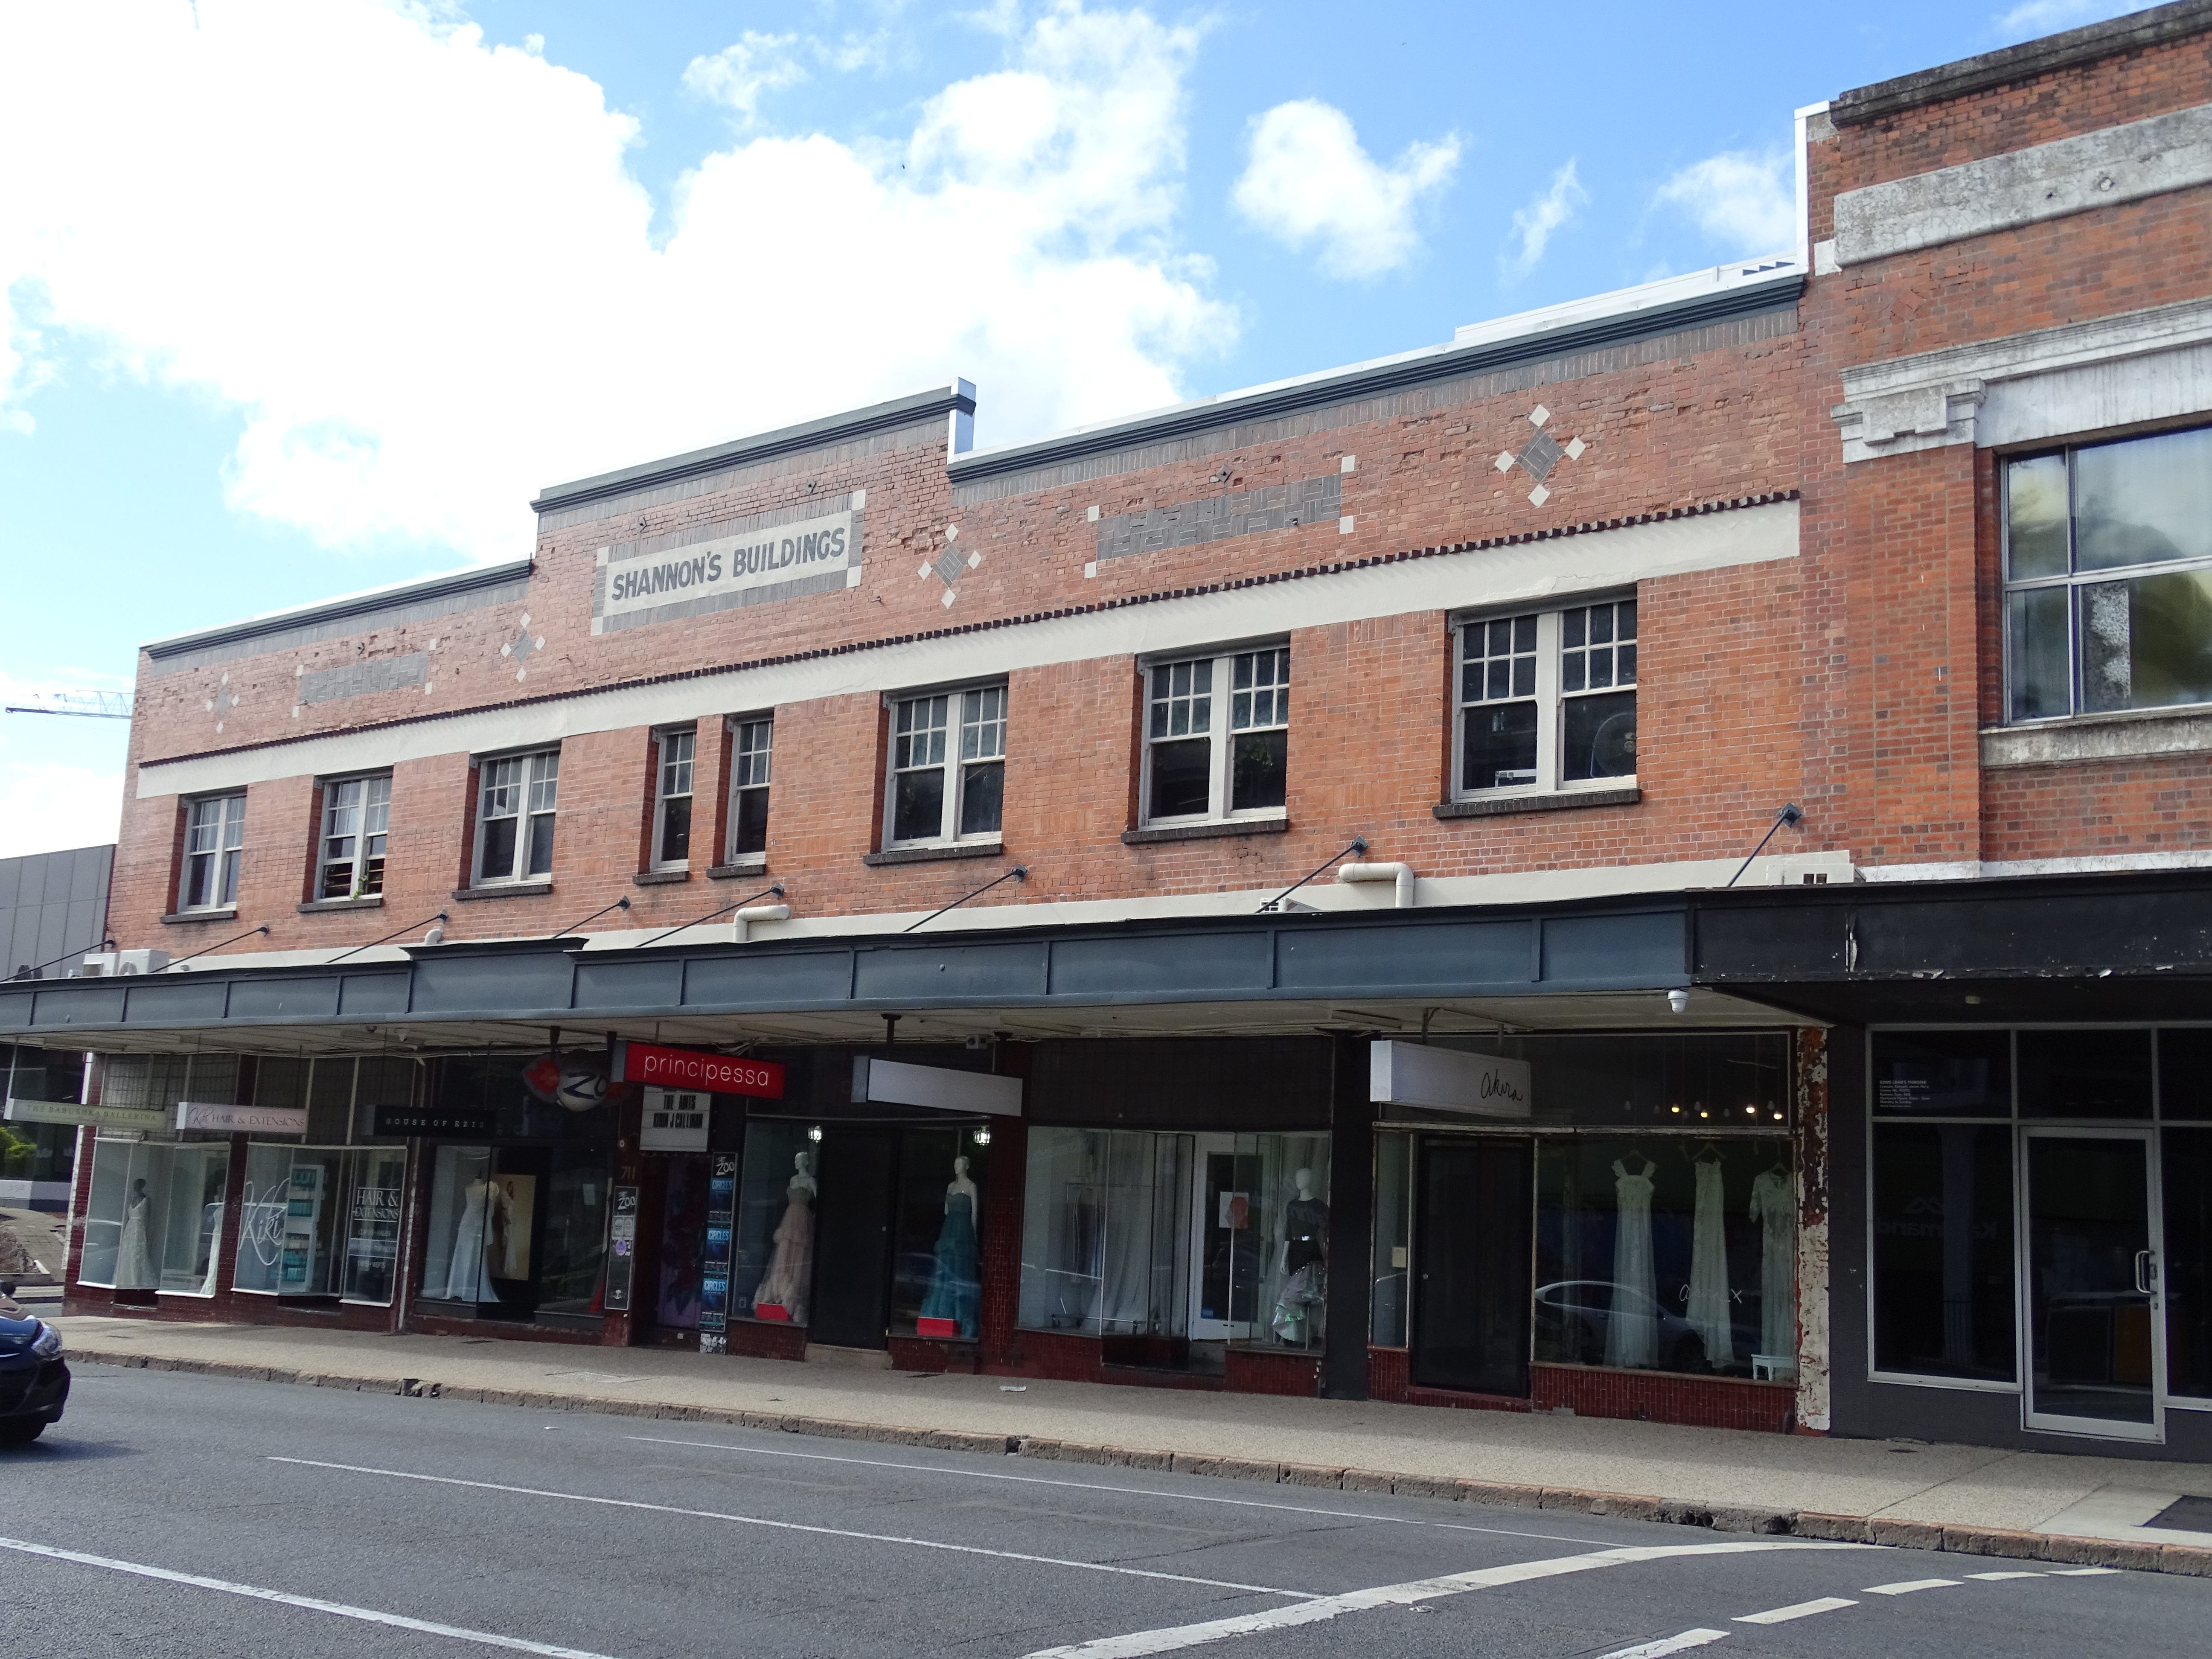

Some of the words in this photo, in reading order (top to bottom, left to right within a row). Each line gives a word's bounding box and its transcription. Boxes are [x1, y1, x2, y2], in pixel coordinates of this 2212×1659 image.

[611, 550, 722, 601] SHANNON'S
[733, 527, 845, 578] BUILDINGS
[644, 1054, 768, 1086] principessa
[103, 1111, 156, 1121] BALLERINA
[212, 1114, 235, 1124] HAIR
[237, 1115, 245, 1124] &
[249, 1115, 306, 1127] EXTENSIONS
[386, 1118, 426, 1126] HOUSE
[716, 1161, 734, 1176] ZOO
[712, 1180, 733, 1190] CIRCLES
[357, 1190, 385, 1206] HAIR
[388, 1191, 399, 1207] &
[617, 1196, 635, 1210] ZOO
[354, 1207, 399, 1220] EXTENSIONS
[238, 1177, 291, 1266] Kiki
[707, 1229, 729, 1241] CIRCLES
[704, 1280, 726, 1292] CIRCLES
